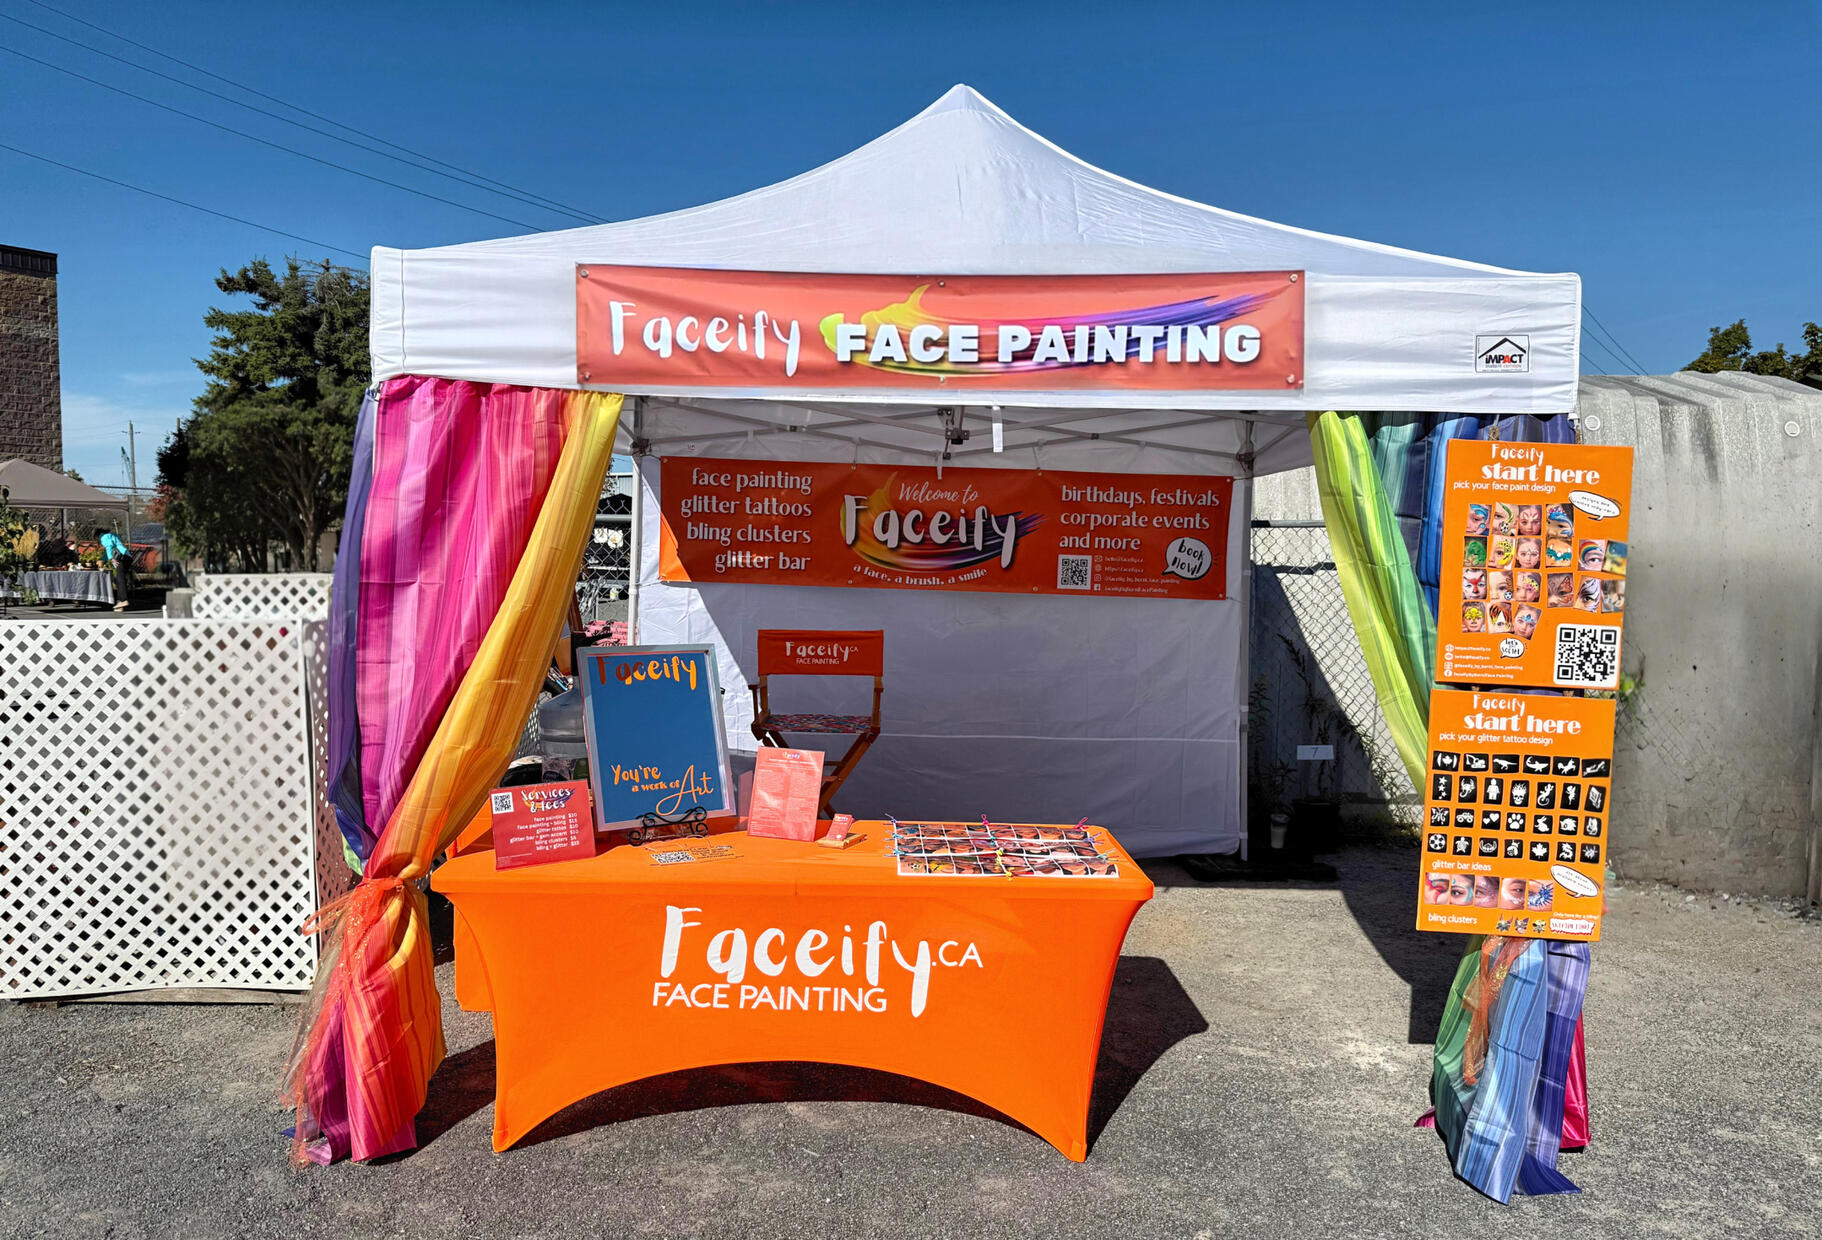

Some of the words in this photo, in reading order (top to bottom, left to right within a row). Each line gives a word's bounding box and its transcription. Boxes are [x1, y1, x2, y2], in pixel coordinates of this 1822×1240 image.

[610, 301, 800, 377] Faceify
[837, 324, 980, 364] FACE
[998, 324, 1262, 364] PAINTING
[1491, 443, 1544, 466] Faceify
[692, 467, 731, 486] face
[736, 470, 813, 495] painting
[1481, 462, 1539, 481] start
[1544, 465, 1600, 485] here
[898, 481, 959, 503] Welcome
[962, 484, 979, 505] to
[1061, 485, 1146, 508] birthdays,
[1150, 487, 1220, 507] festivals
[1453, 480, 1470, 490] pick
[1472, 482, 1490, 491] your
[1492, 481, 1509, 491] face
[1510, 482, 1530, 492] paint
[1531, 483, 1556, 494] design
[681, 494, 740, 518] glitter
[745, 496, 812, 517] tattoos
[844, 494, 1016, 569] Faceify
[1060, 511, 1148, 530] corporate
[1152, 513, 1210, 530] events
[687, 521, 732, 546] bling
[736, 523, 812, 544] clusters
[1059, 532, 1090, 549] and
[1094, 536, 1141, 550] more
[715, 550, 774, 573] glitter
[778, 551, 811, 570] bar
[1178, 539, 1203, 561] book
[853, 564, 862, 572] a
[894, 575, 902, 583] a
[948, 575, 956, 584] a
[958, 568, 988, 582] smile
[785, 641, 849, 662] Faceify
[595, 655, 697, 691] Faceify
[1473, 694, 1526, 717] Faceify
[1464, 712, 1521, 731] start
[1526, 715, 1582, 735] here
[1439, 732, 1456, 742] pick
[1457, 733, 1476, 743] your
[1477, 732, 1501, 743] glitter
[1502, 734, 1528, 744] tattoo
[1528, 734, 1554, 746] design
[611, 764, 661, 785] You're
[641, 781, 667, 791] work
[669, 779, 680, 789] of
[656, 764, 714, 816] Art
[1431, 859, 1456, 870] glitter
[1456, 860, 1470, 870] bar
[1471, 861, 1492, 871] ideas
[1428, 912, 1447, 925] bling
[1447, 914, 1478, 925] clusters
[652, 982, 730, 1008] FACE
[739, 985, 887, 1012] PAINTING
